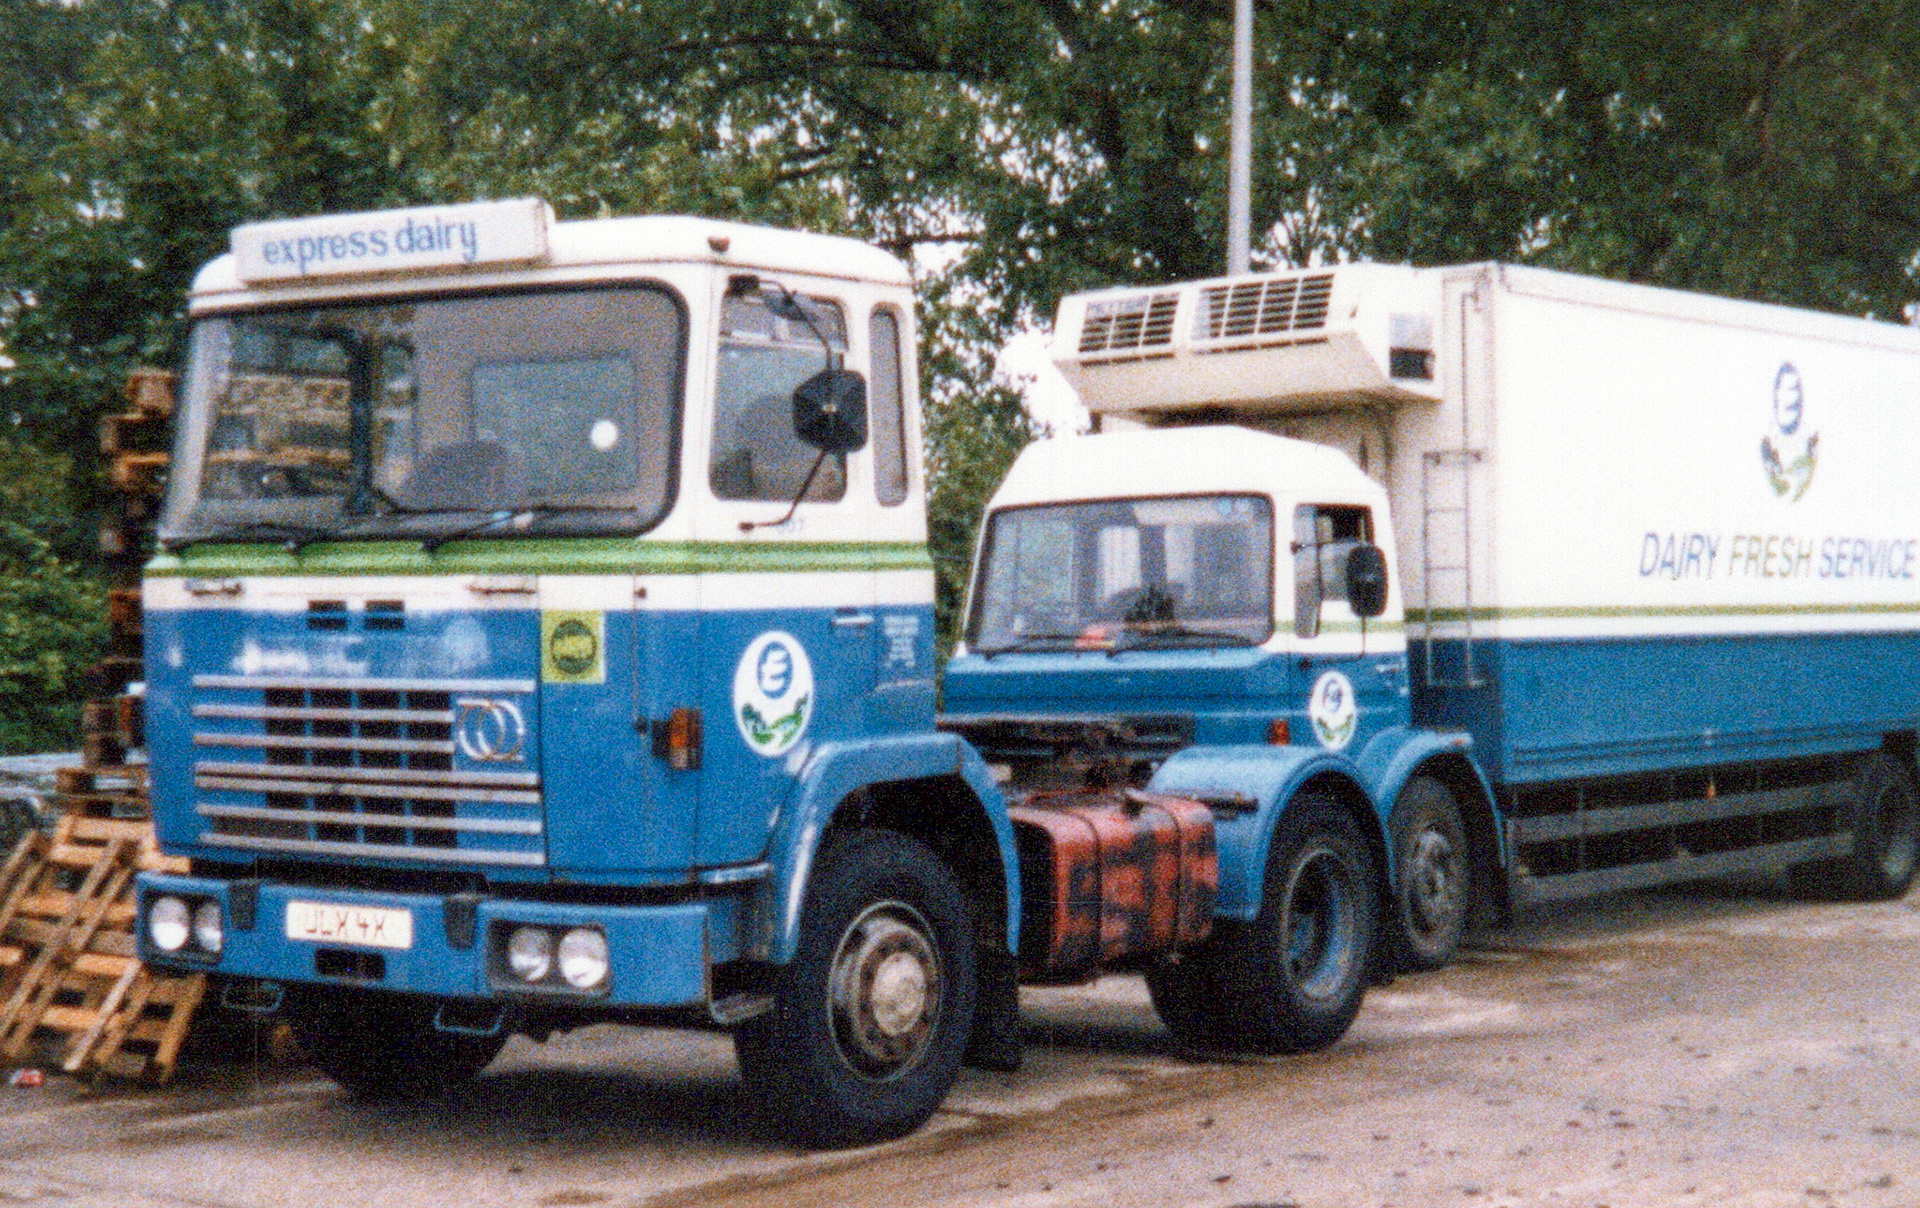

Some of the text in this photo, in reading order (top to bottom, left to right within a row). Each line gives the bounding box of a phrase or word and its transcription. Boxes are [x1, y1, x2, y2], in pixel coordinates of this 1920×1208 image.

[261, 216, 479, 274] express dairy
[1640, 532, 1917, 579] DAIRY FRESH SERVICE
